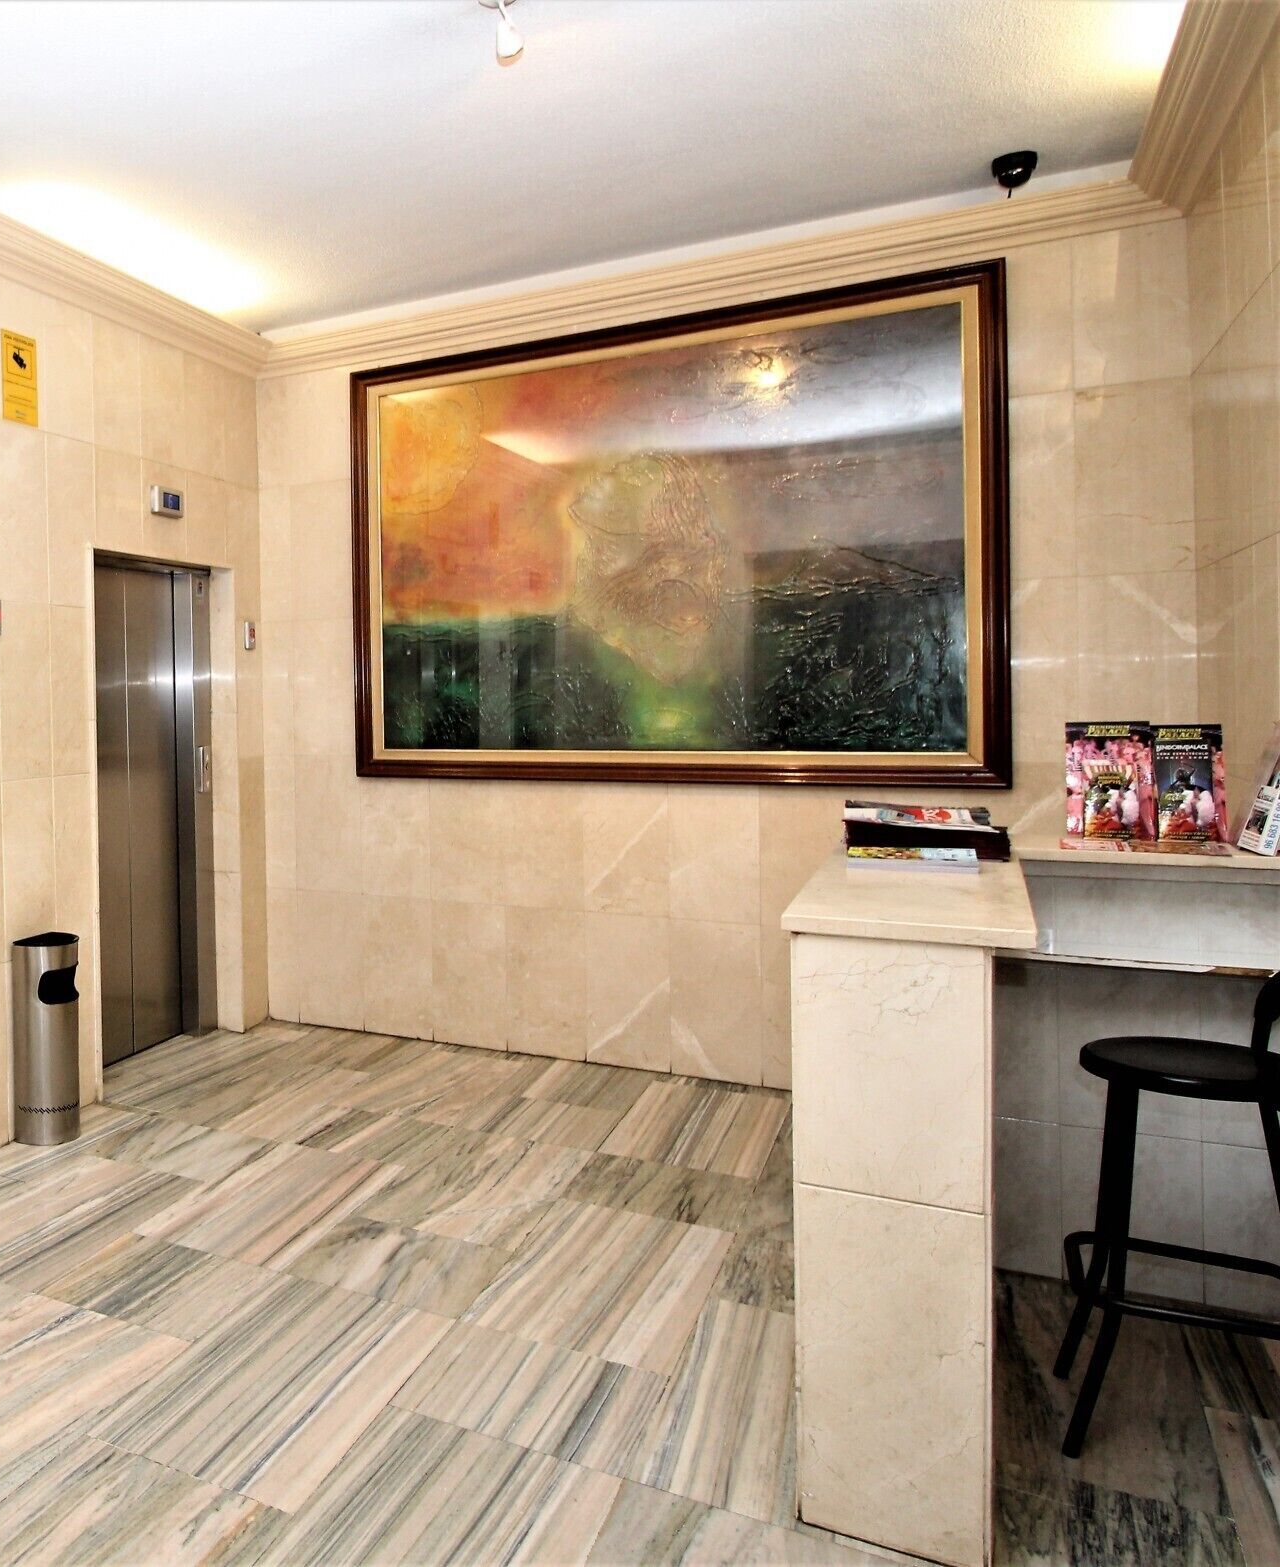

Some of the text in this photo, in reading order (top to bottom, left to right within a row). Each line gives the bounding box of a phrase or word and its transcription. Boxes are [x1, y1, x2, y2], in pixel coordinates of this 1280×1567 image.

[1087, 727, 1129, 736] PALACE
[1158, 731, 1201, 739] PALACE
[1267, 824, 1279, 839] 683
[1264, 839, 1274, 849] 96
